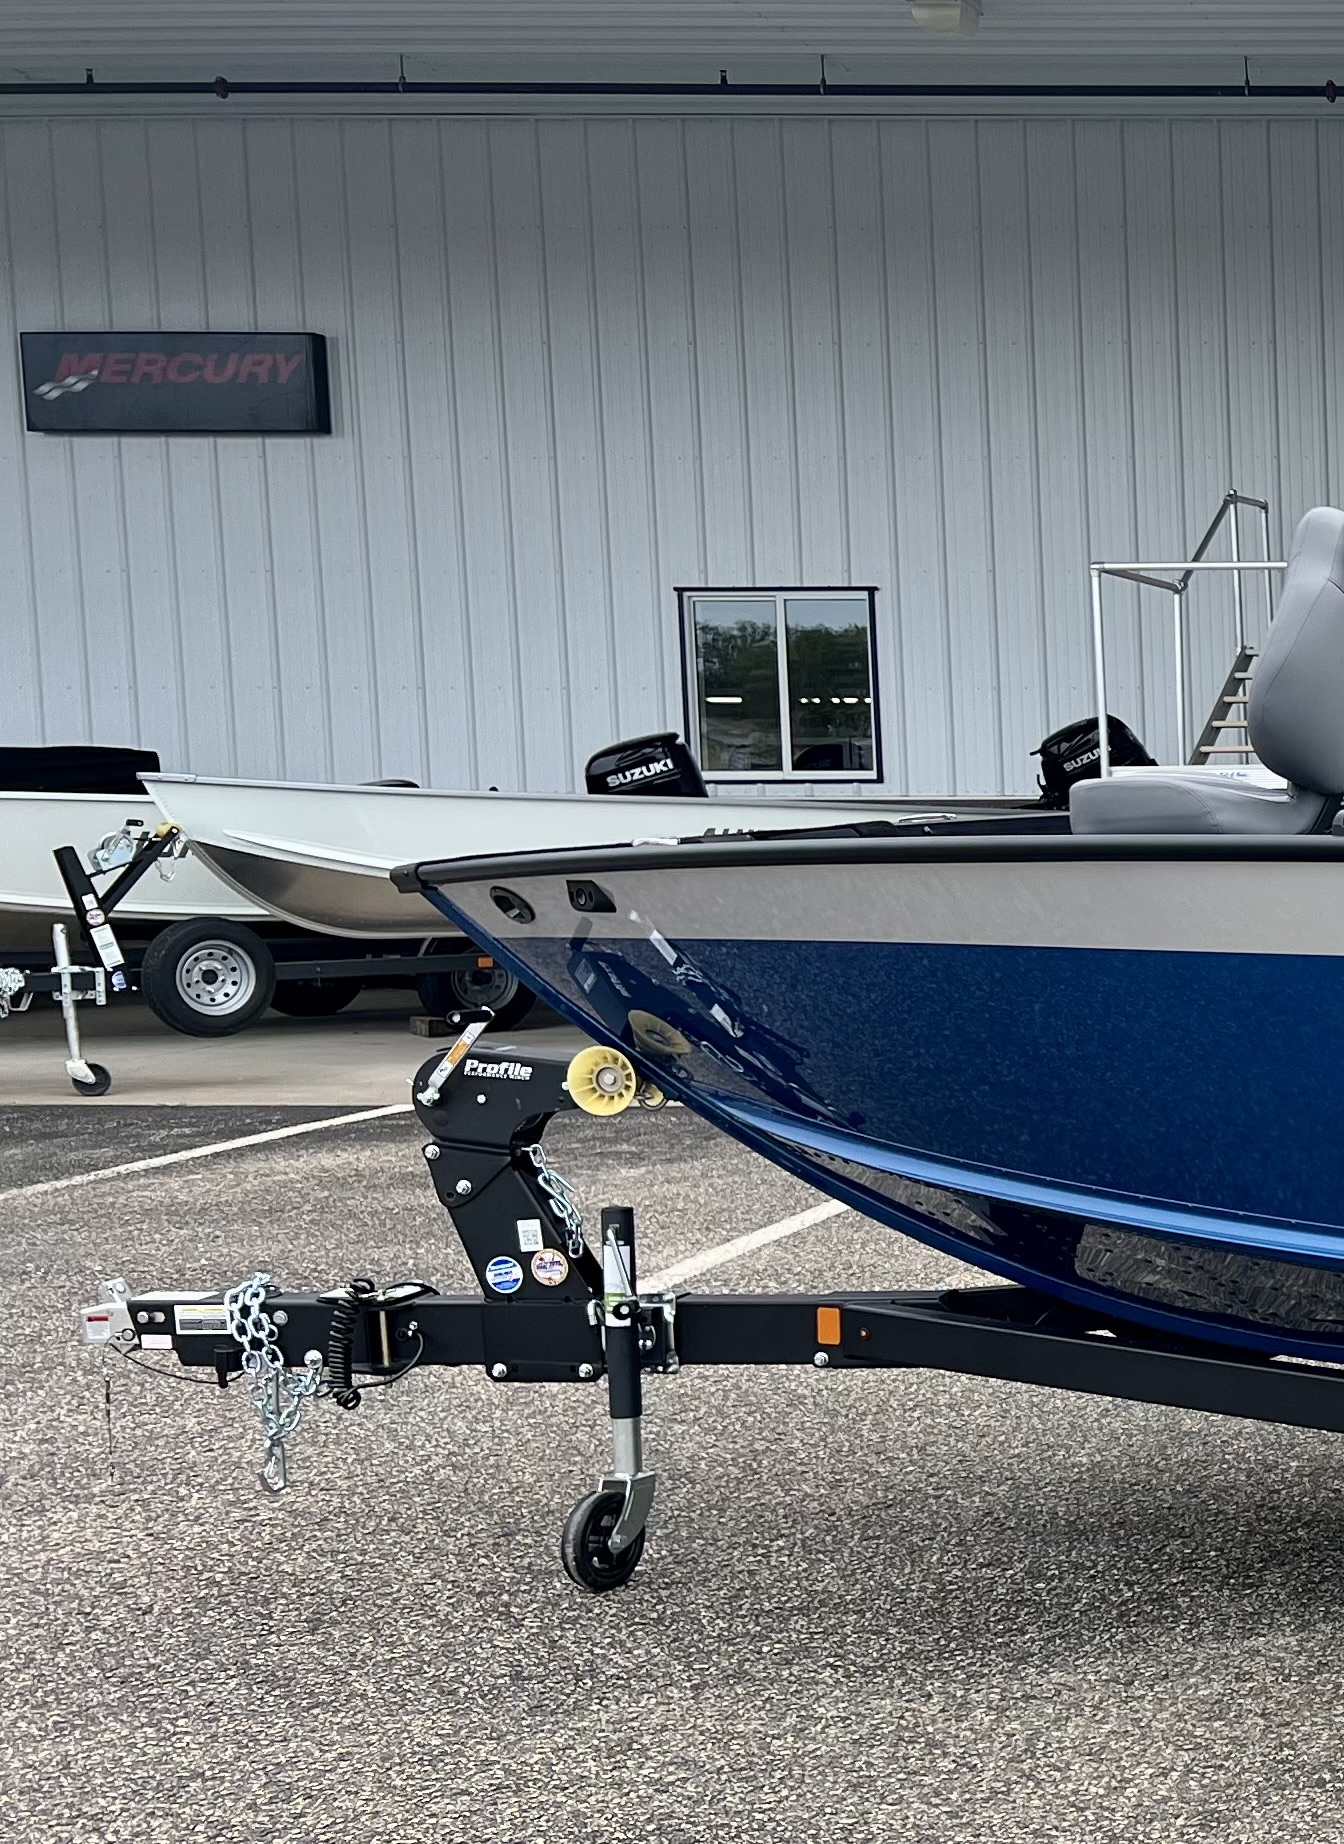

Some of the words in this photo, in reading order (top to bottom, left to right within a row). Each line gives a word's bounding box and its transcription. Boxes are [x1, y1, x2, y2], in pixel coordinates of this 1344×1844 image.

[55, 352, 307, 385] MERCURY
[1063, 745, 1112, 772] SUZU
[606, 759, 674, 787] SUZUKI
[464, 1059, 533, 1077] Profile
